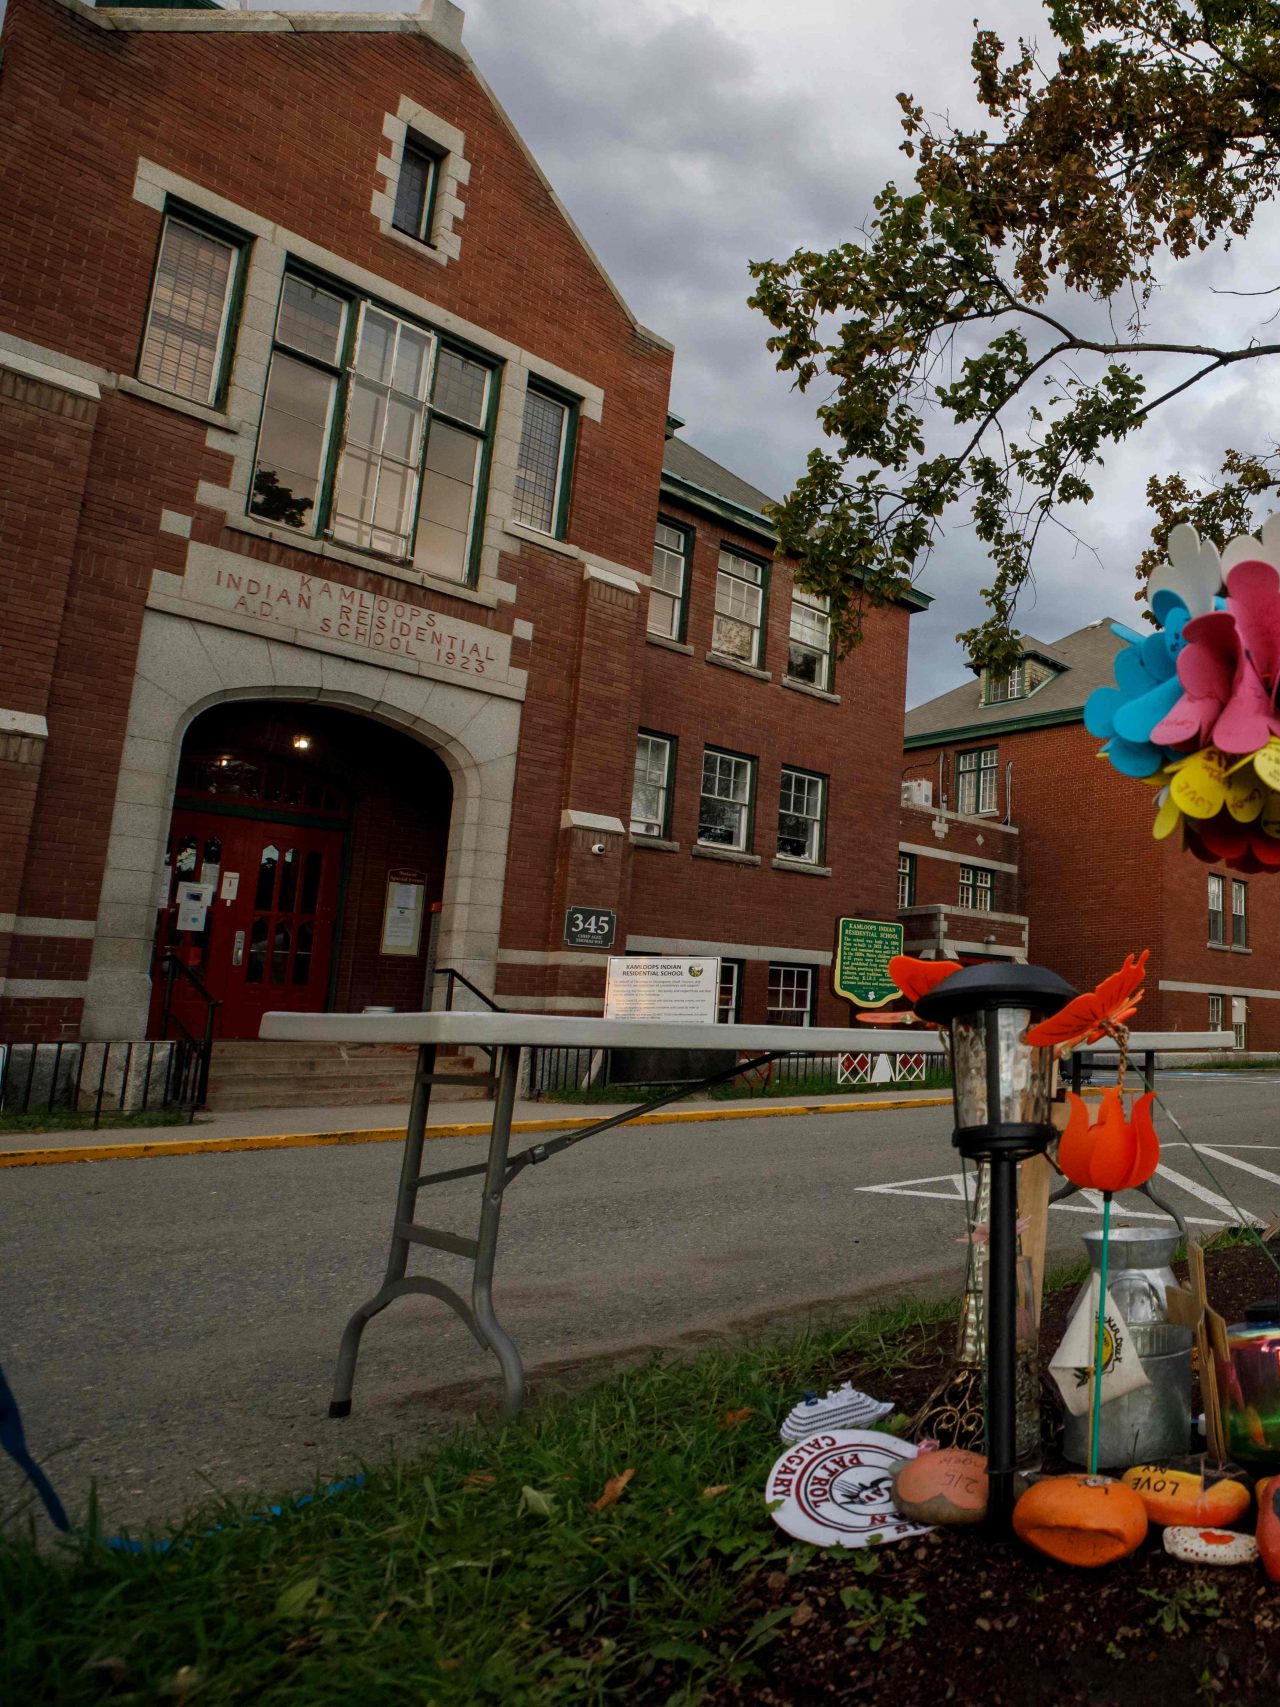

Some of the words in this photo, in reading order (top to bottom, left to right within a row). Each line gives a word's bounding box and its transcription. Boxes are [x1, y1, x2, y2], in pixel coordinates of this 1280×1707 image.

[214, 569, 312, 610] INDIAN
[338, 604, 496, 662] RESIDENTIAL
[300, 574, 437, 628] KAMLOOPS
[233, 594, 281, 622] A.D.
[319, 617, 418, 657] SCHOOL
[435, 647, 486, 674] 1923
[572, 913, 609, 934] 345
[845, 929, 877, 937] RESIDENTIAL
[849, 923, 876, 931] KAMLOOPS
[773, 1435, 837, 1498] CALGARY
[809, 1453, 864, 1508] PATROL
[1132, 1477, 1179, 1496] LOVE
